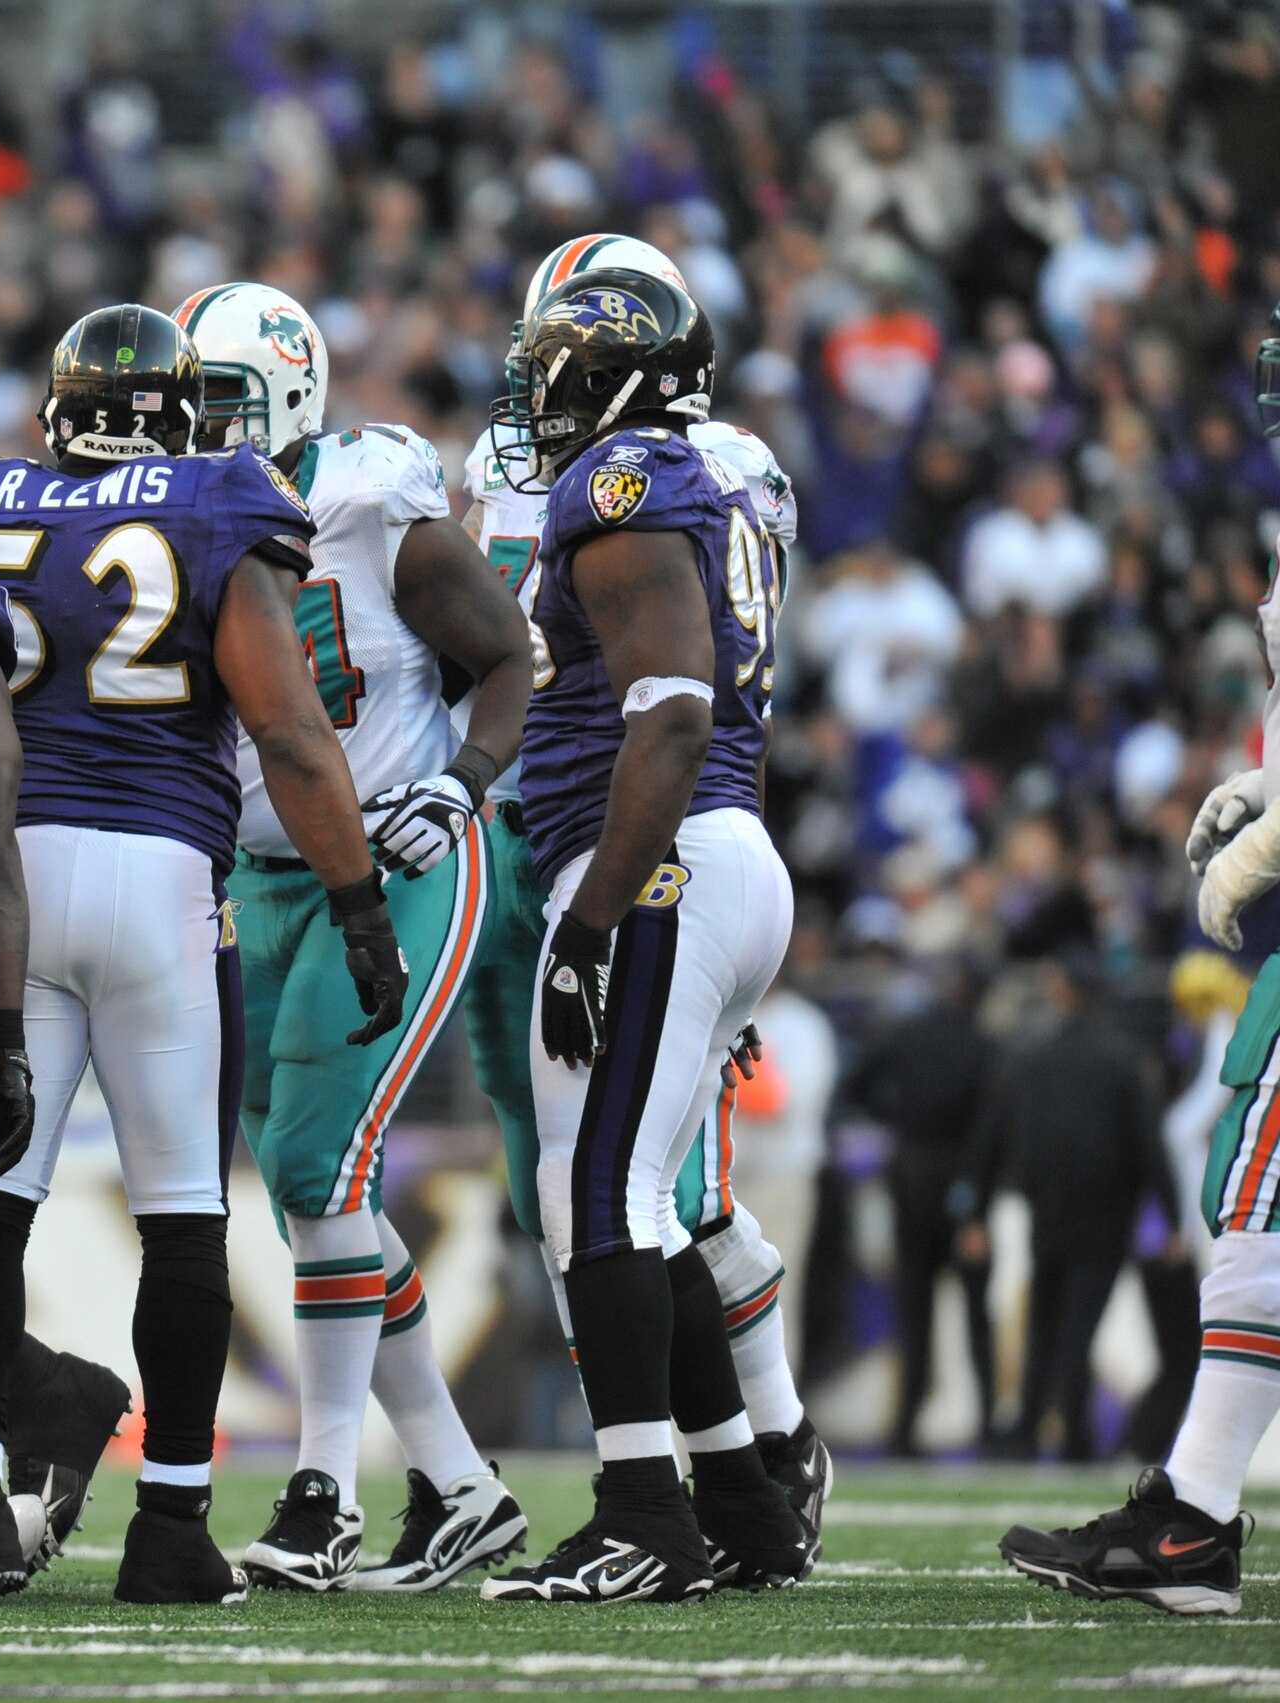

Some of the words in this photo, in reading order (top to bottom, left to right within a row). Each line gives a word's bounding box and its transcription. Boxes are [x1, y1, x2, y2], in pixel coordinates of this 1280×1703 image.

[82, 439, 155, 455] RAVENS
[39, 465, 173, 508] LEWIS
[599, 465, 643, 479] RAVENS
[727, 506, 776, 690] 9
